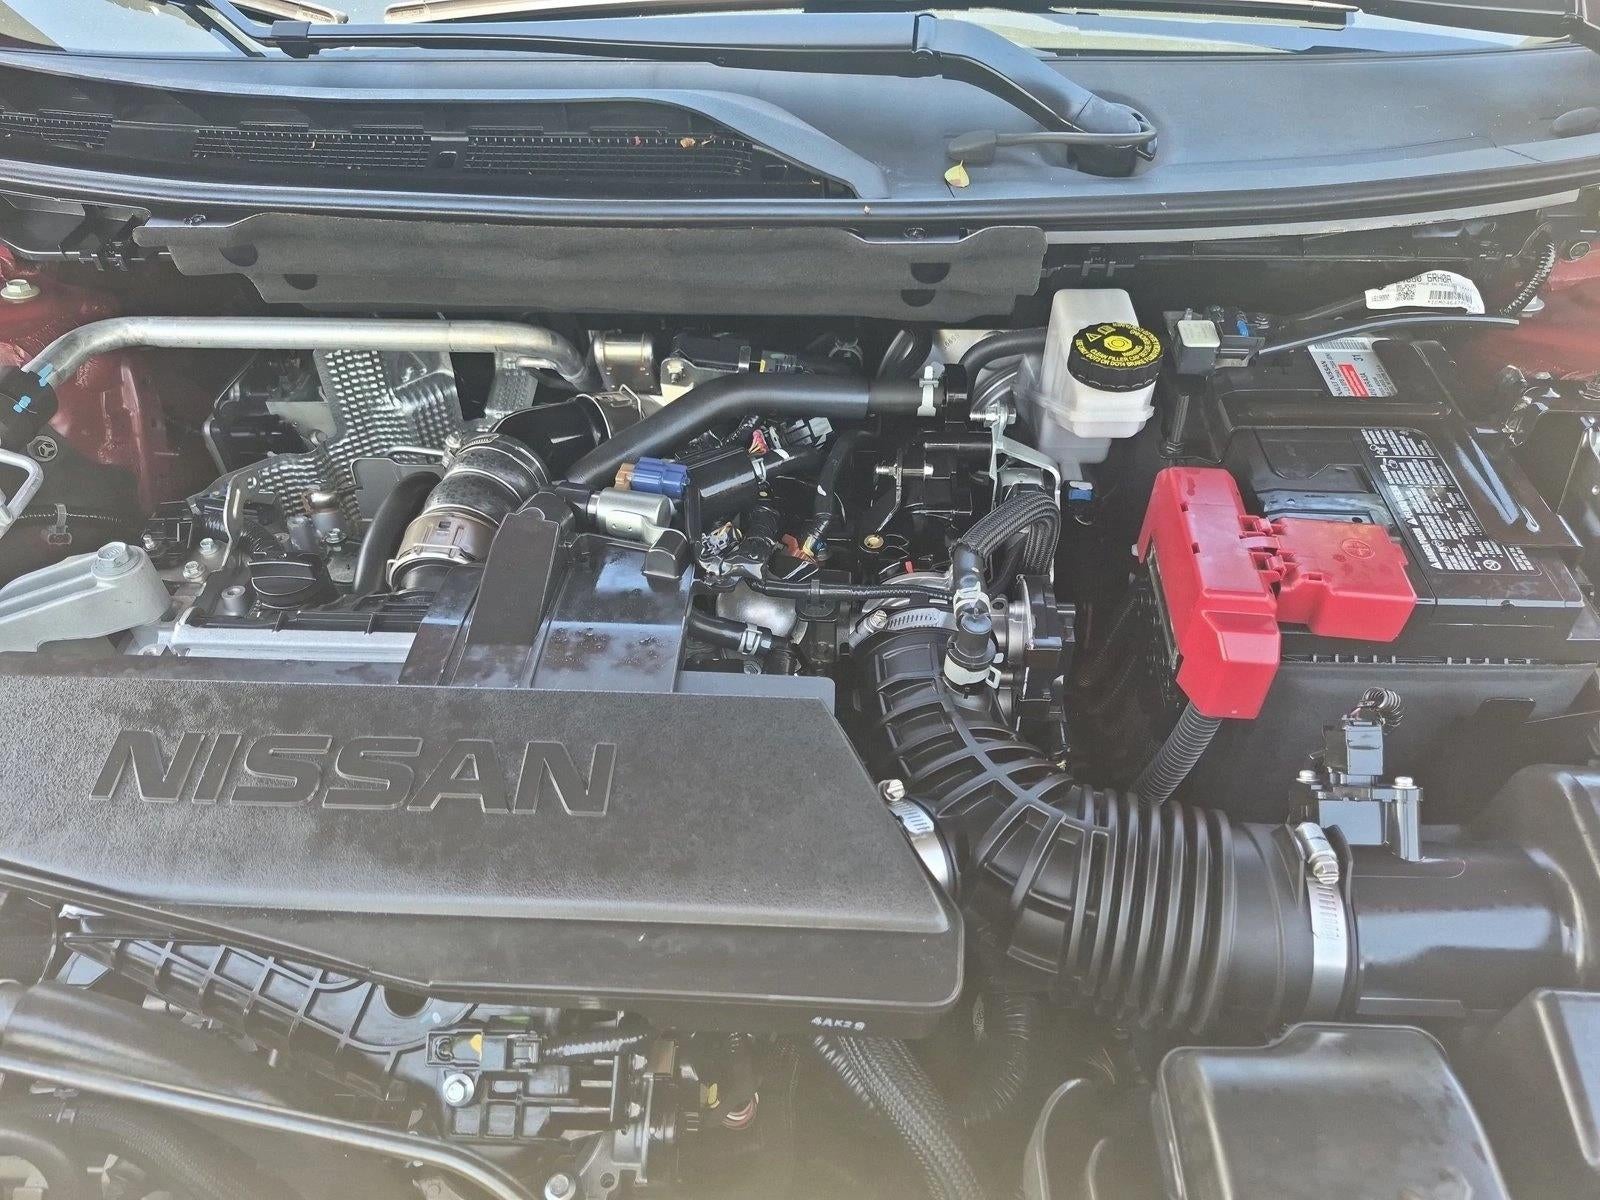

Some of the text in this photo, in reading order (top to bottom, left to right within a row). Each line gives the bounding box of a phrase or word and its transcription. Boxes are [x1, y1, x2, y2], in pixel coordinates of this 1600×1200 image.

[1090, 349, 1108, 360] CLEAN
[1108, 355, 1130, 363] FILLER
[89, 729, 617, 816] NISSAN
